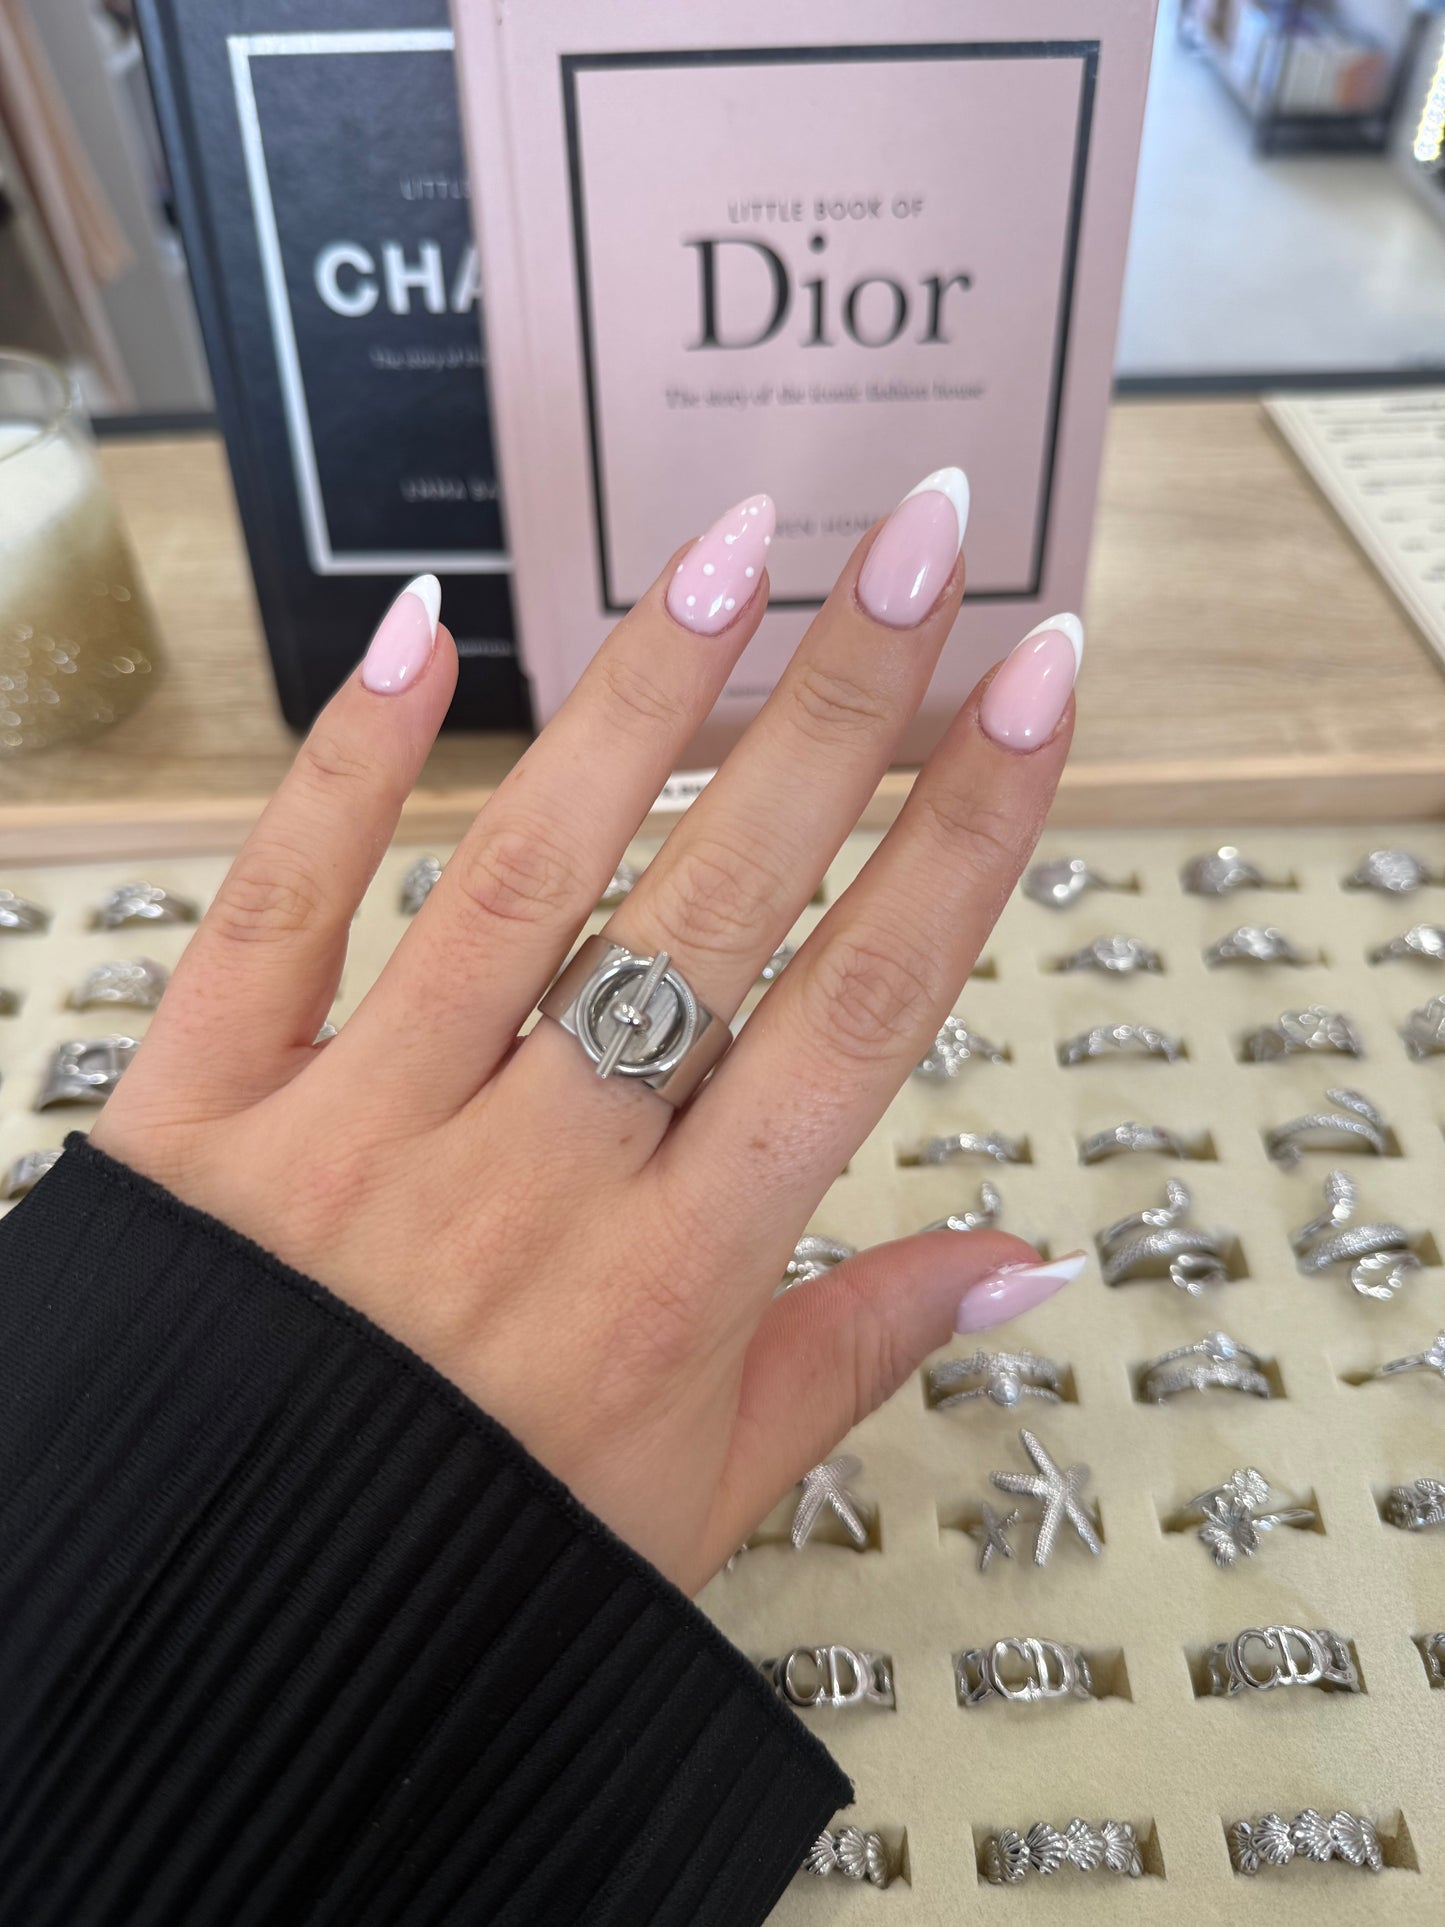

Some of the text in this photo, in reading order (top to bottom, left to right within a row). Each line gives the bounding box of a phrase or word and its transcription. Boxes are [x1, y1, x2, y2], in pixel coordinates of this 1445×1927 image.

[727, 198, 926, 223] LITTLE BOOK OF
[683, 233, 974, 352] Dior
